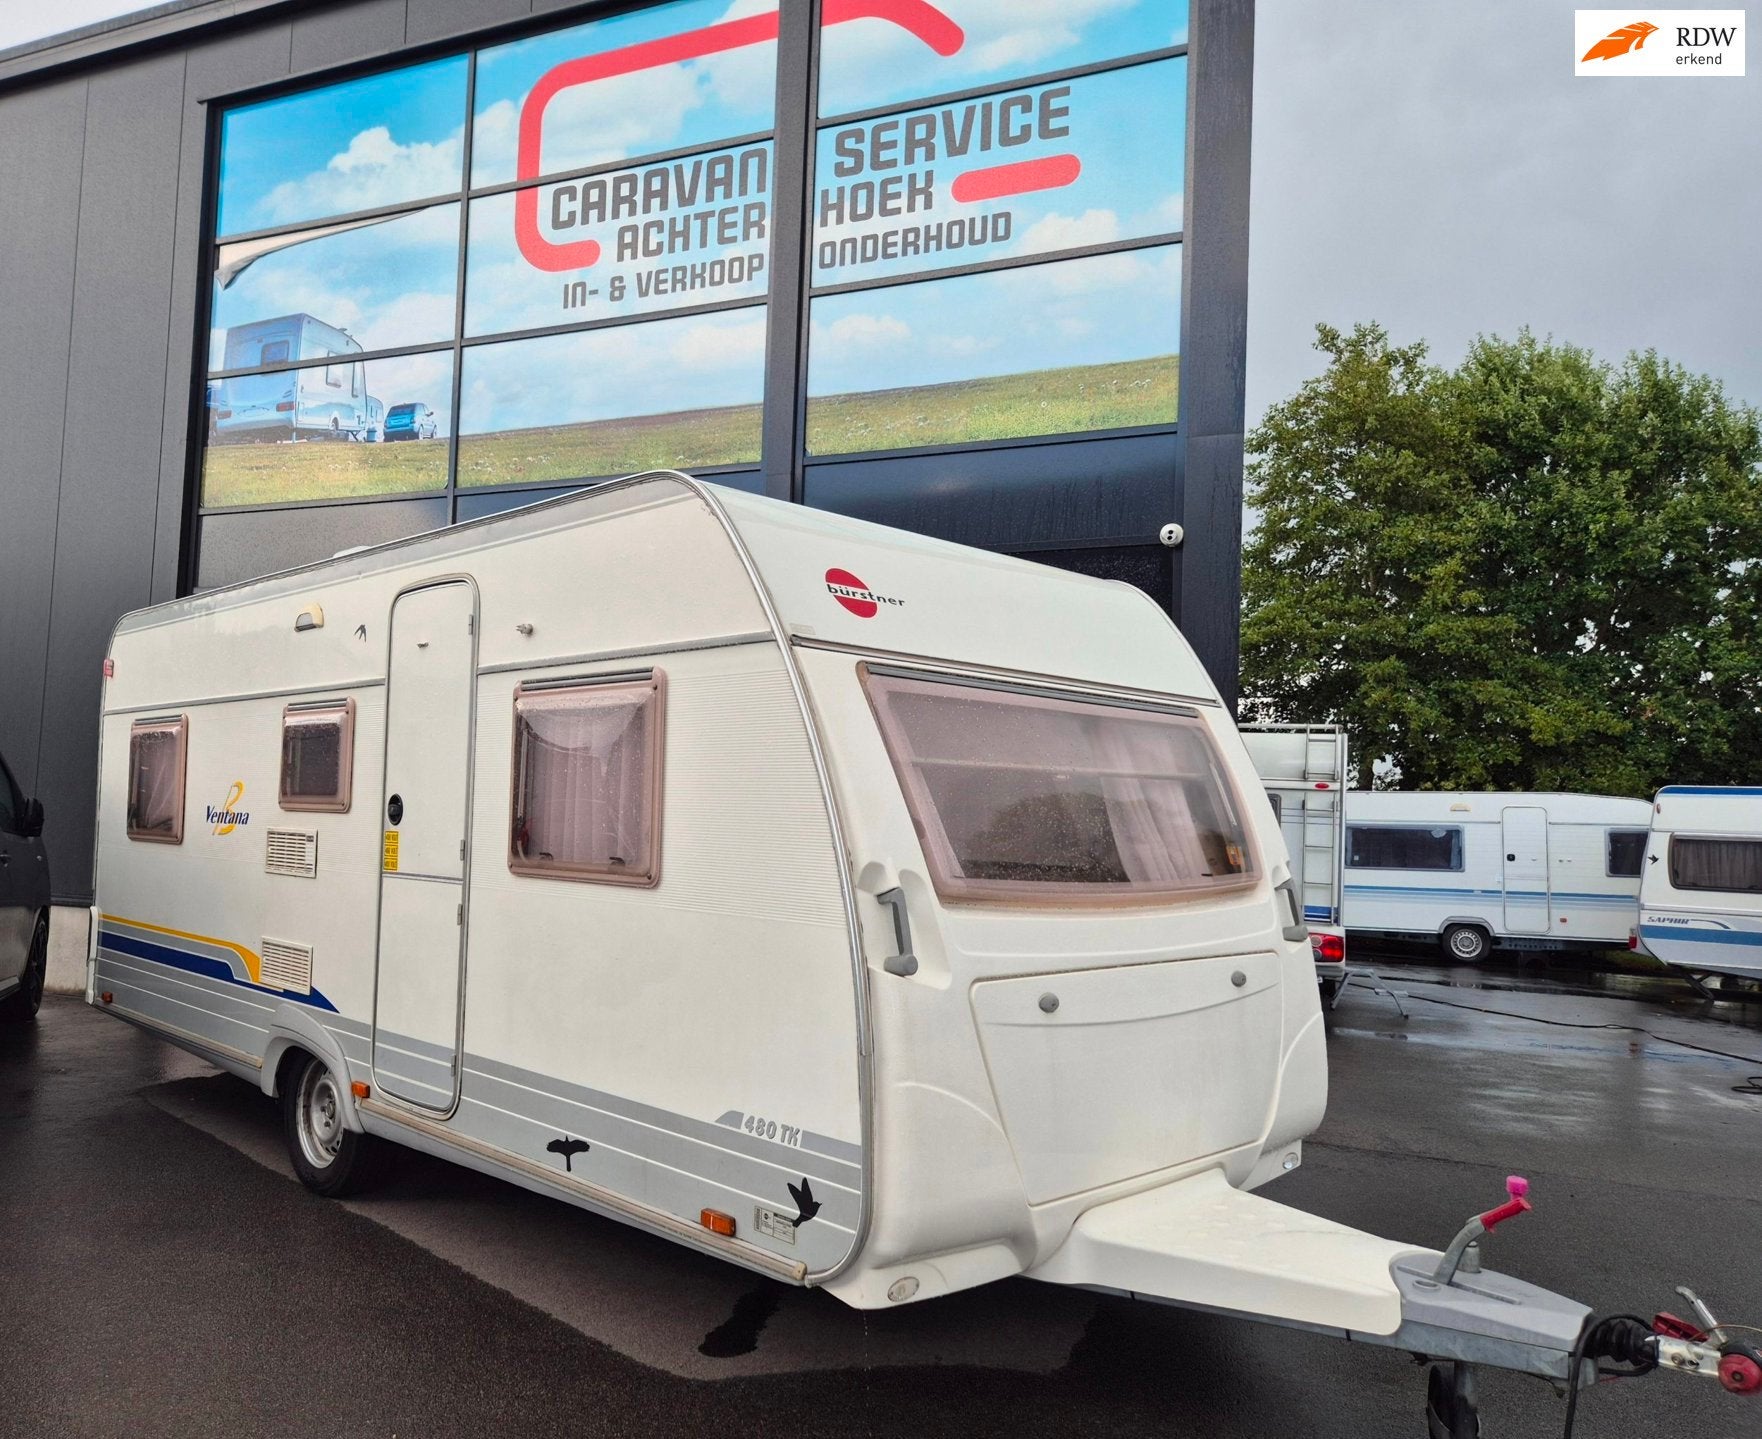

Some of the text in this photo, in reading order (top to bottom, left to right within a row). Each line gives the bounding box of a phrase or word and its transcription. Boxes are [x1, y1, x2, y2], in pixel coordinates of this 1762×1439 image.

[551, 87, 1071, 231] CARAVAN SERVICE
[616, 170, 934, 263] ACHTER HOEK
[609, 275, 626, 302] &
[636, 253, 764, 298] VERKOOP
[818, 211, 1012, 270] ONDERHOUD
[826, 583, 905, 606] bürstner
[206, 804, 250, 825] Ventana
[744, 1115, 801, 1147] 480 TK
